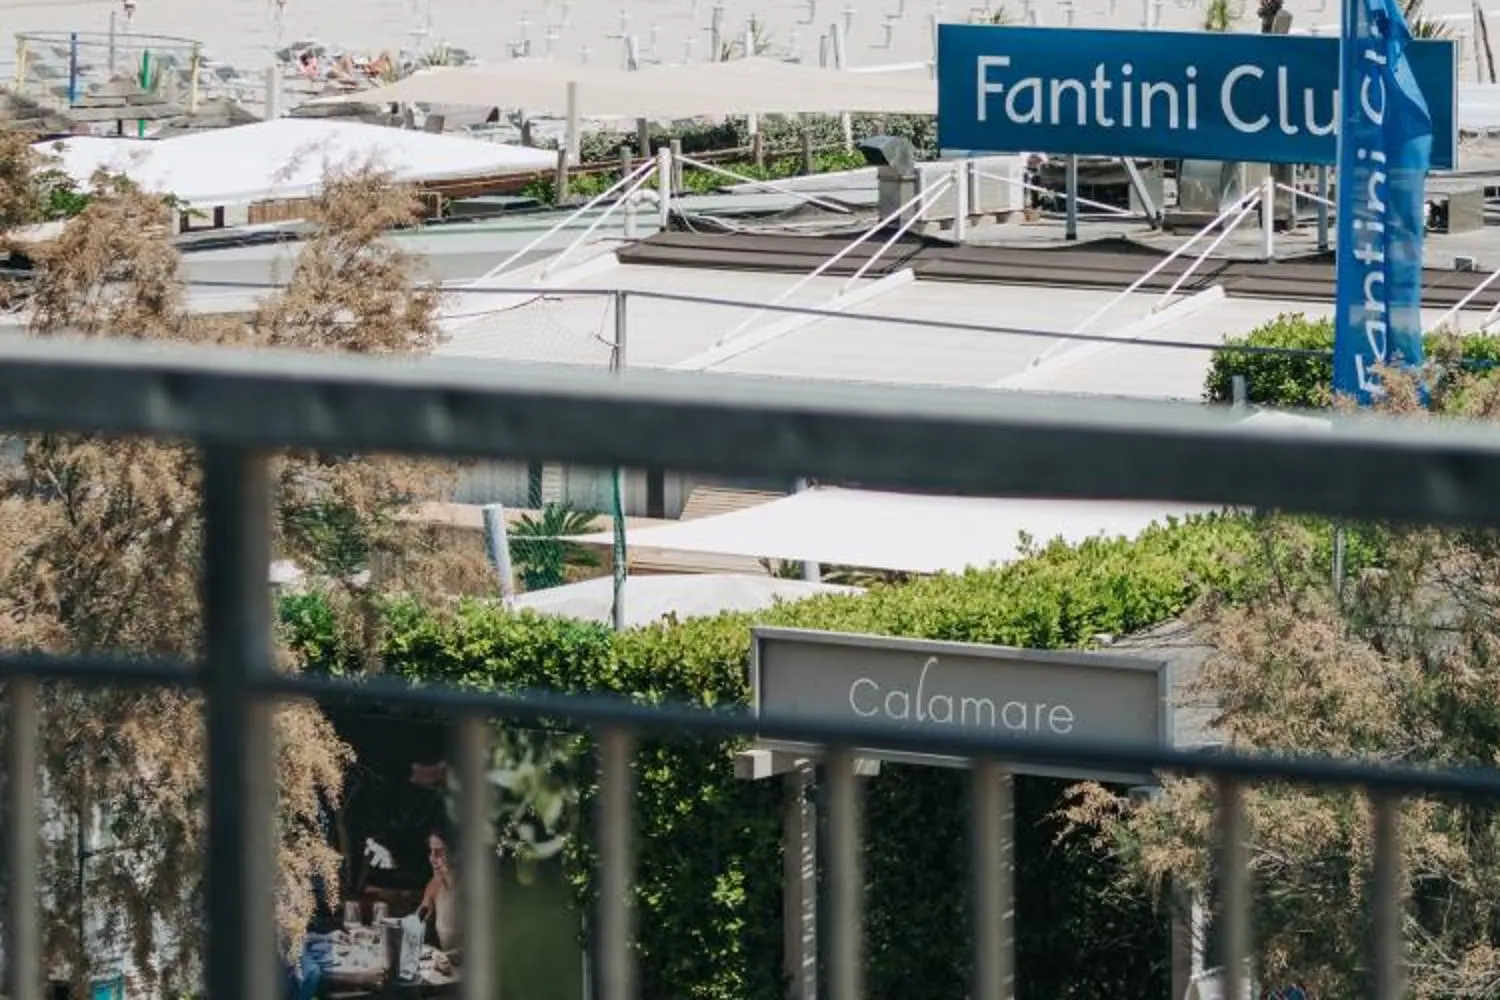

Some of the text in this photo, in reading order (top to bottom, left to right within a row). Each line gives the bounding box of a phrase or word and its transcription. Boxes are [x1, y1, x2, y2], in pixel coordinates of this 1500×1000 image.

[976, 55, 1340, 136] Fantini Clu
[1352, 22, 1388, 395] Fantini Cl
[849, 656, 1074, 734] Calamare
